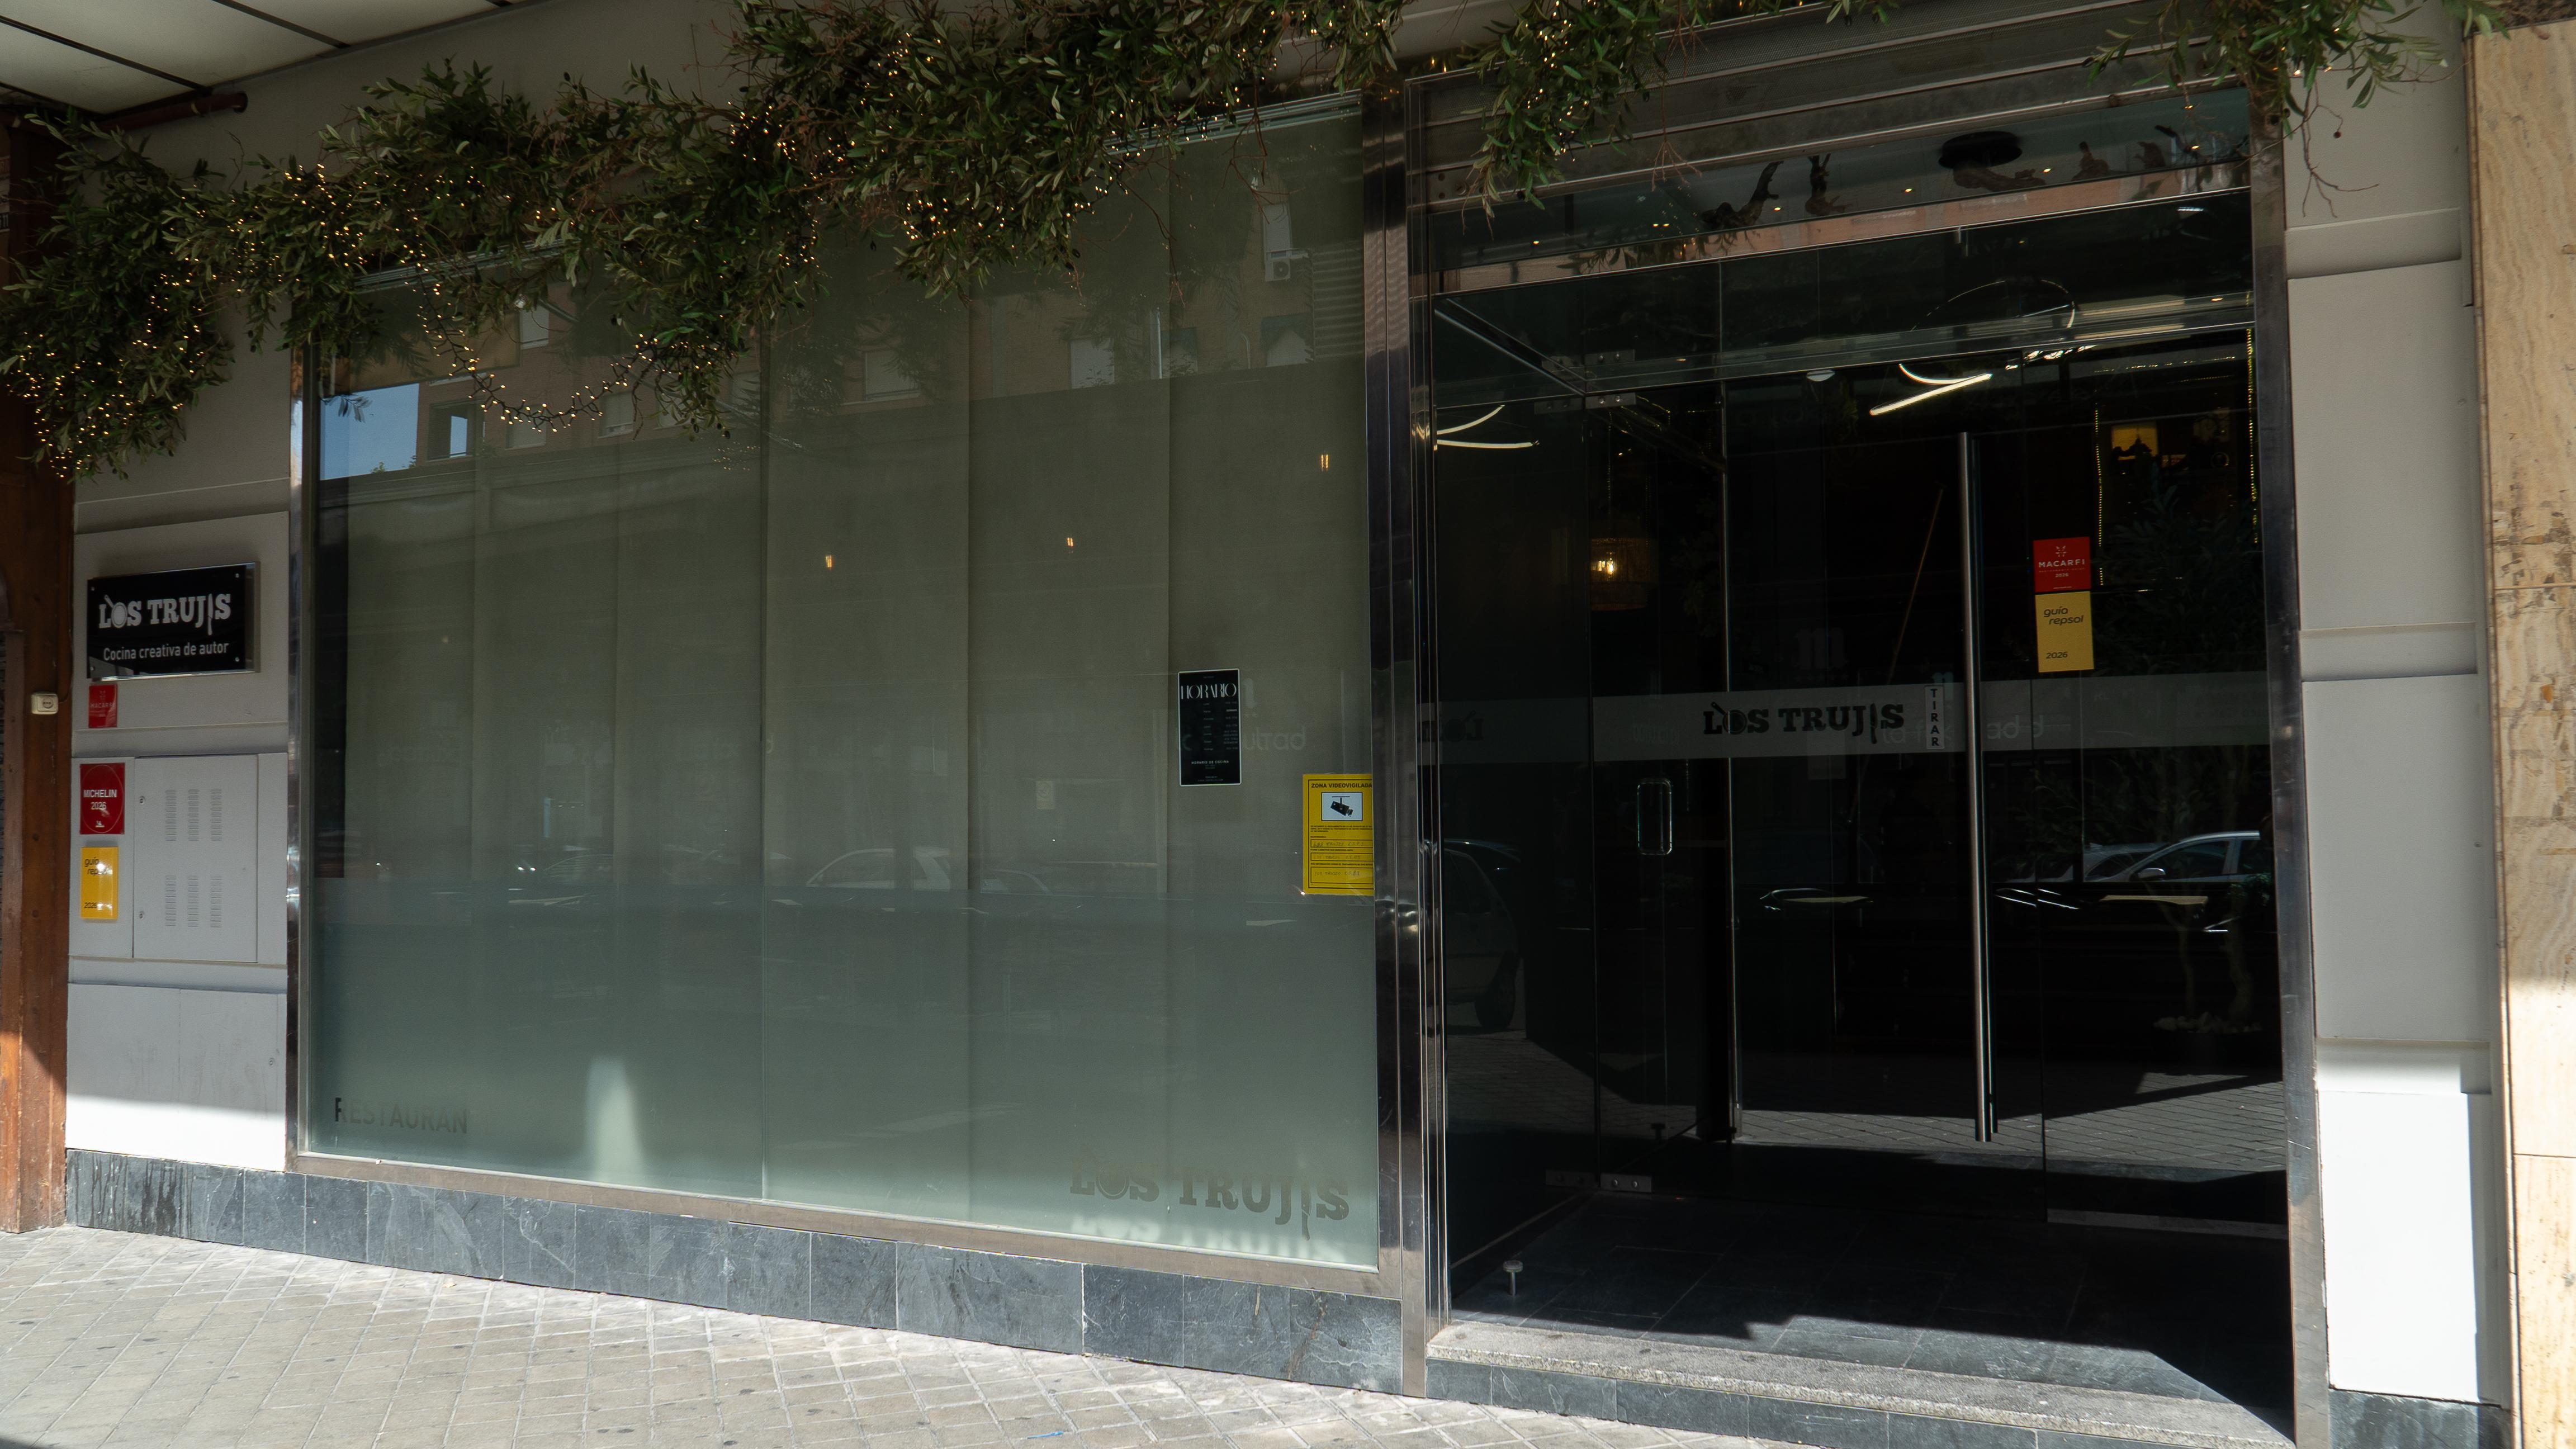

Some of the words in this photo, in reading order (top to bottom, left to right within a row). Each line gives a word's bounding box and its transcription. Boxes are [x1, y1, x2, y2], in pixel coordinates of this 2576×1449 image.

[2039, 559, 2085, 567] MACARFI
[99, 594, 142, 628] LOS
[2044, 606, 2068, 618] guía
[2049, 615, 2084, 626] repsol
[103, 646, 136, 661] Cocina
[139, 643, 181, 659] creativa
[183, 642, 196, 656] de
[199, 642, 229, 655] autor
[1181, 683, 1237, 699] HORARIO
[1703, 702, 1769, 735] LOS
[1930, 688, 1940, 746] TIRAR
[83, 789, 117, 798] MICHELIN
[91, 802, 107, 810] 2026
[1069, 1144, 1160, 1202] LOS
